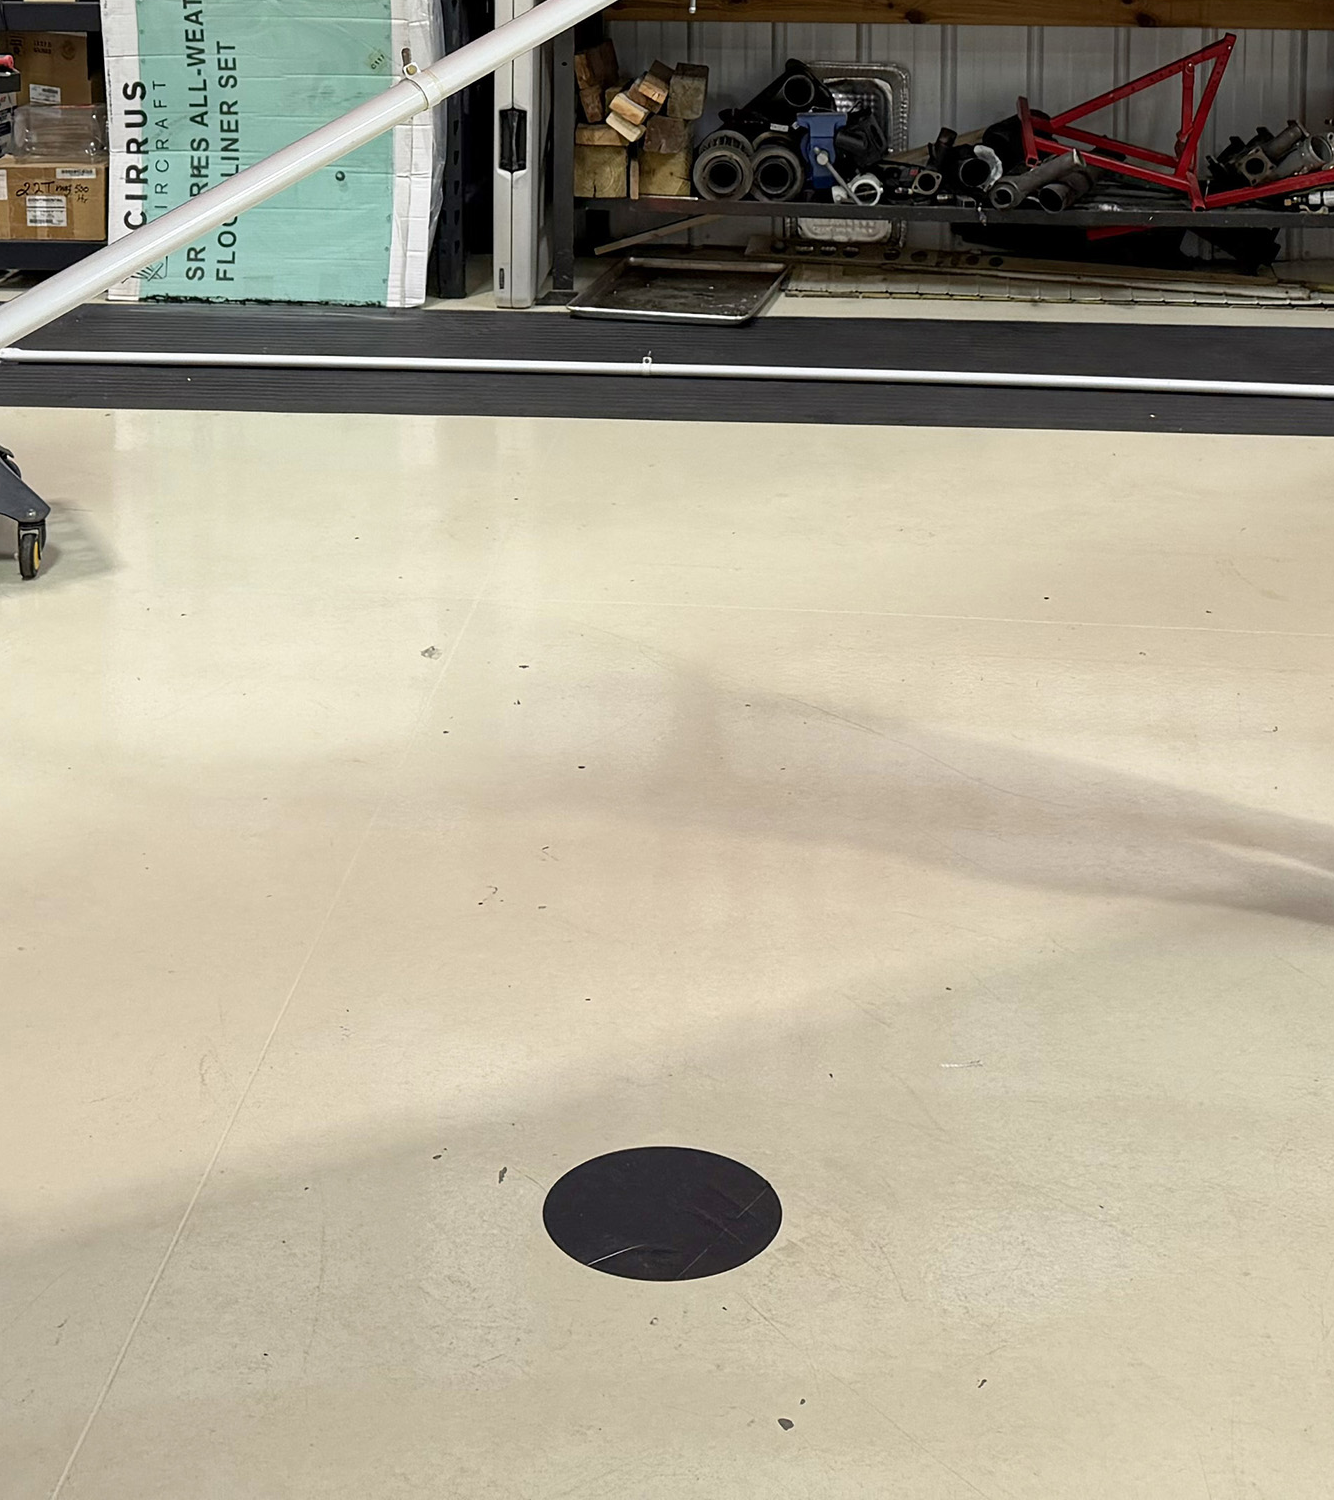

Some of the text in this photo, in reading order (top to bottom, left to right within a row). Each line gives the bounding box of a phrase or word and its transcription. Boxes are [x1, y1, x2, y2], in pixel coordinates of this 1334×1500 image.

[123, 81, 149, 231] CIRRUS
[152, 80, 170, 209] IRCRAFT
[190, 137, 209, 197] RIES
[216, 40, 240, 282] FLO LINER SET
[186, 246, 206, 281] SR
